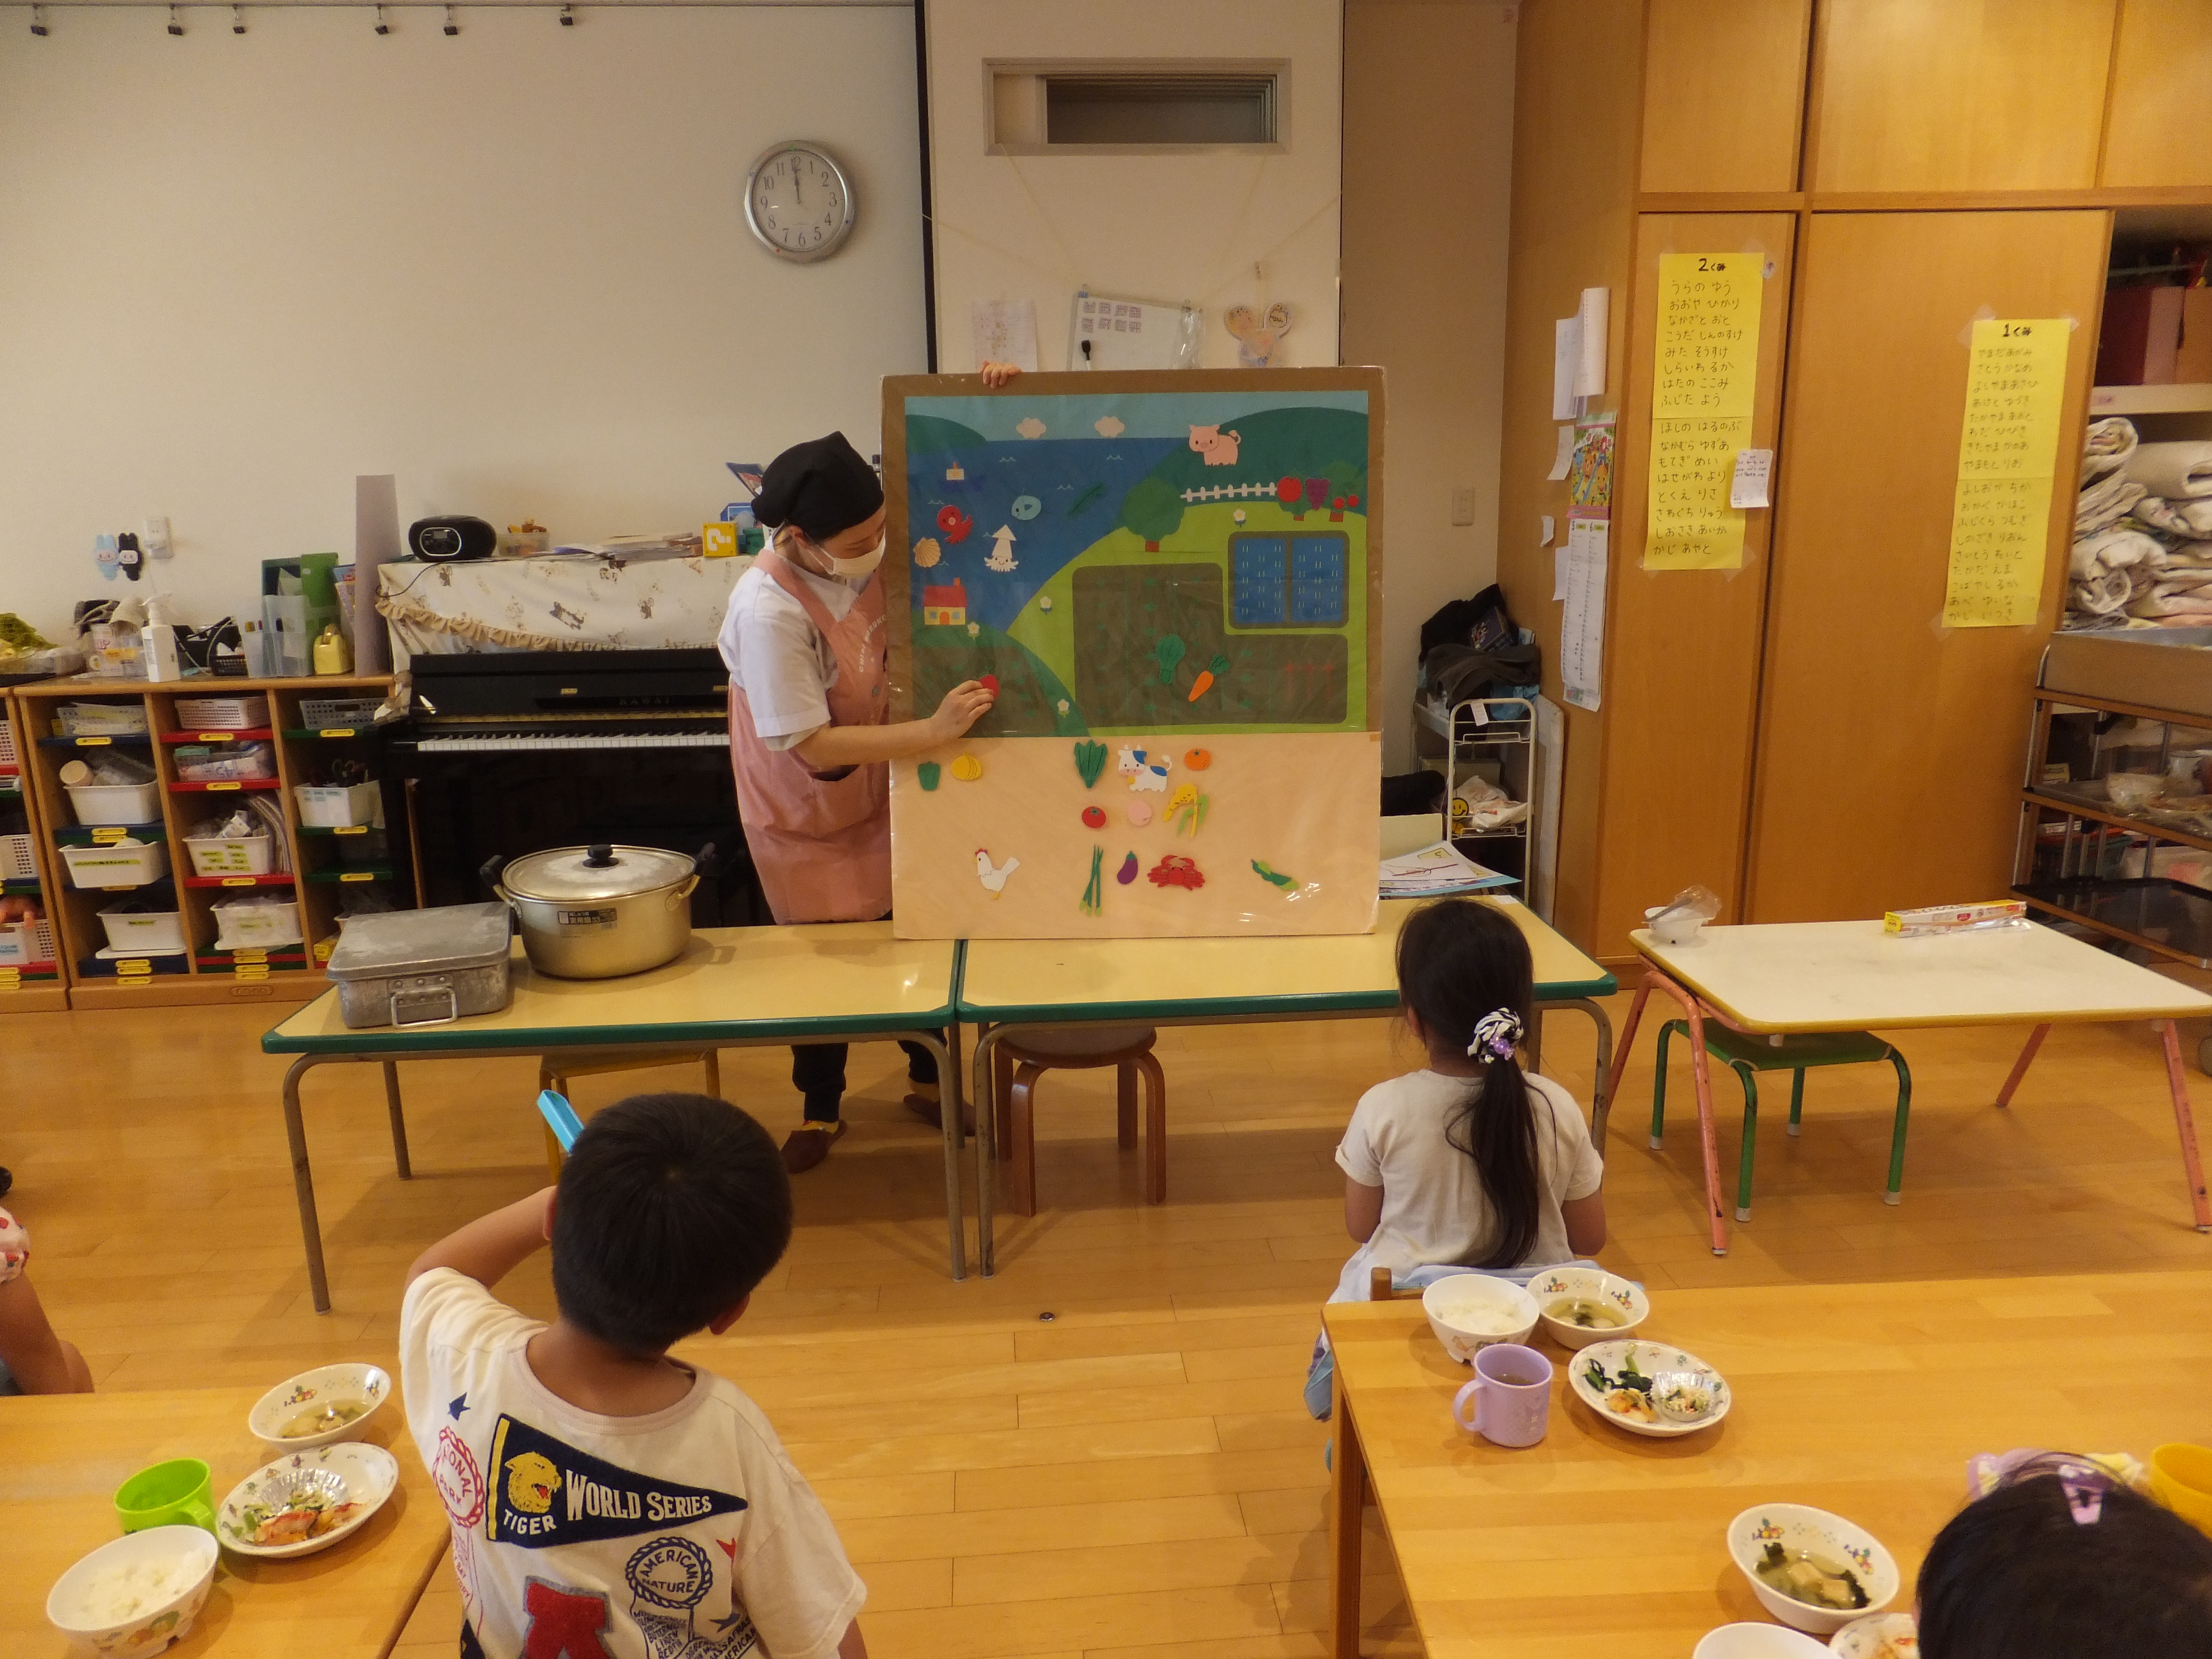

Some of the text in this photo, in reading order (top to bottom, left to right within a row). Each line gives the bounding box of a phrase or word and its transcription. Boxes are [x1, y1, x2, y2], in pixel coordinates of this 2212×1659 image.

[776, 162, 785, 176] 11
[810, 160, 813, 174] 1
[763, 175, 774, 190] 10
[822, 172, 829, 187] 2
[760, 196, 768, 211] 9
[829, 192, 837, 207] 3
[769, 215, 776, 229] 8
[824, 212, 831, 226] 4
[783, 228, 789, 243] 7
[798, 232, 805, 246] 6
[814, 227, 821, 240] 5
[1667, 329, 1743, 342] こうだ しんのすけ
[566, 1469, 712, 1521] WORLD SERIES
[503, 1509, 557, 1535] TIGER
[639, 1550, 698, 1580] AMERICAN
[641, 1578, 695, 1593] NATURE
